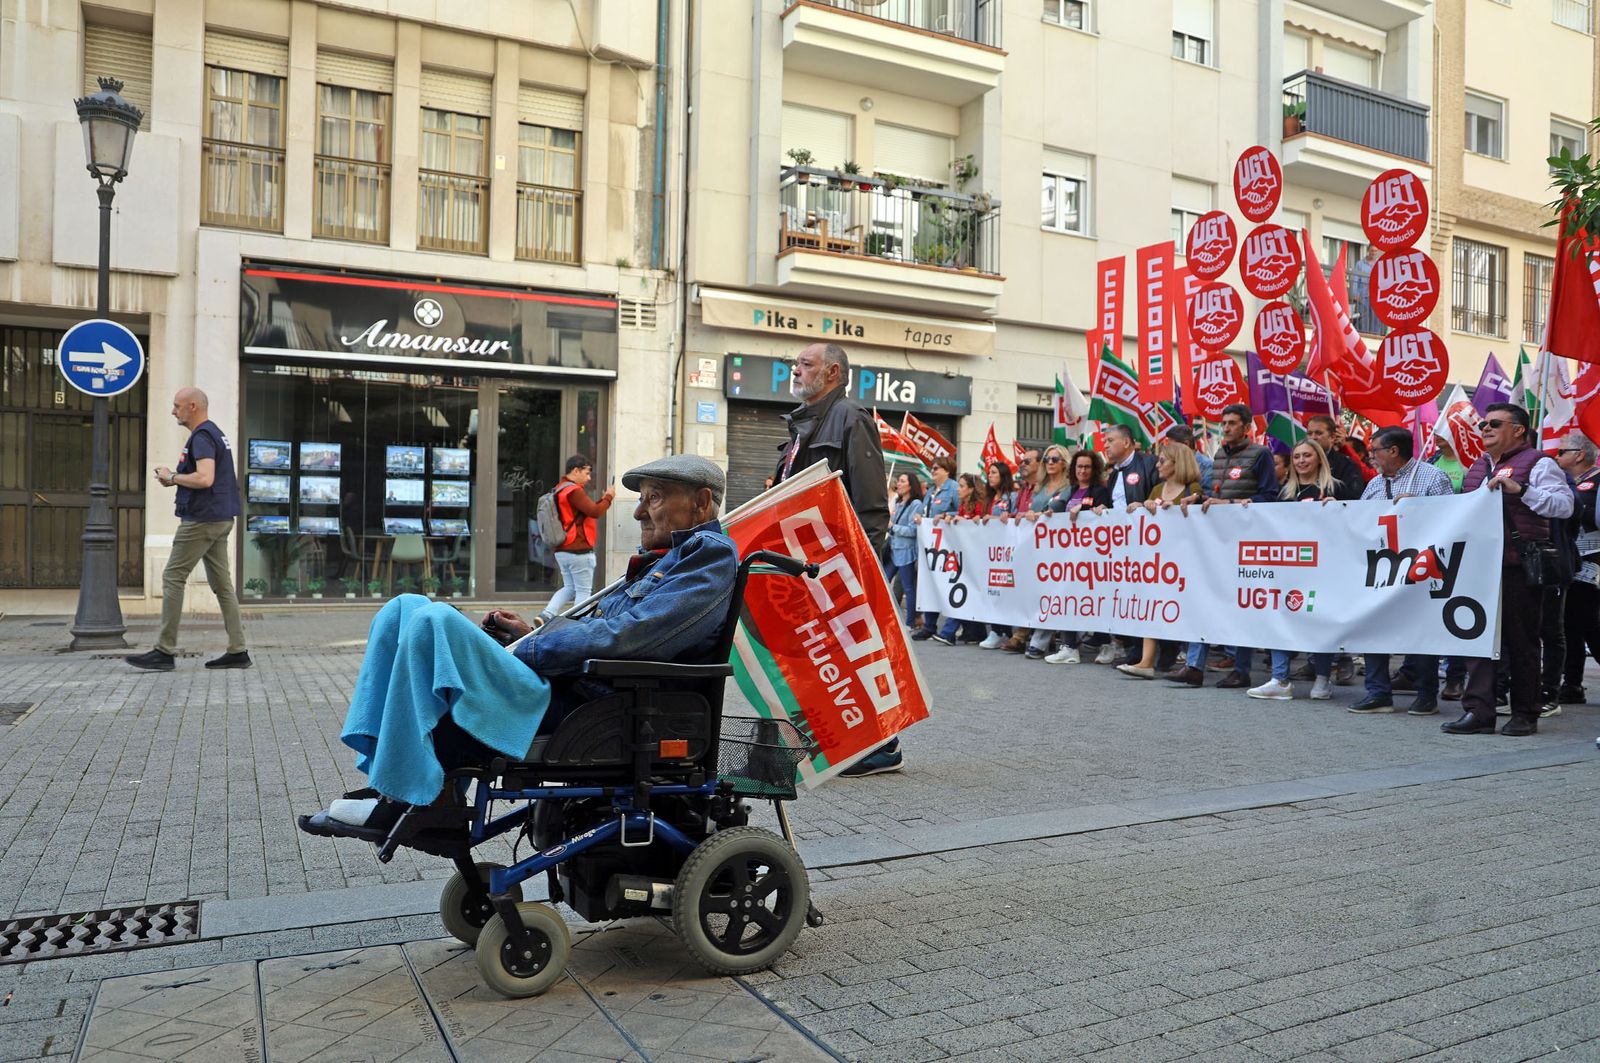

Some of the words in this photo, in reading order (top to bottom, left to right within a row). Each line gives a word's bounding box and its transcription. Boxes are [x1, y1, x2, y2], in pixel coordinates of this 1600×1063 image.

[1238, 150, 1272, 188] UGT
[1369, 173, 1415, 215] UGT
[1192, 214, 1230, 249] UGT
[1246, 228, 1290, 265] UGT
[1378, 228, 1416, 245] Andalucía
[1256, 278, 1289, 291] Andalucía
[1377, 252, 1427, 289] UGT
[1146, 256, 1164, 352] CCOO
[1194, 287, 1233, 320] UGT
[1386, 305, 1425, 321] Andalucía
[340, 319, 512, 356] Amansur
[753, 309, 798, 330] Pika
[822, 317, 865, 338] Pika
[904, 327, 953, 347] tapas
[1260, 306, 1297, 340] UGT
[1384, 331, 1434, 365] UGT
[858, 370, 916, 404] Pika
[1200, 359, 1234, 389] UGT
[1394, 384, 1434, 399] Andalucía
[1035, 521, 1132, 555] Proteger
[1139, 515, 1162, 546] lo
[1242, 546, 1294, 562] CCOO
[1036, 552, 1186, 592] conquistado,
[1238, 567, 1275, 580] Huelva
[779, 506, 901, 715] CCOO
[1039, 594, 1105, 623] ganar
[1112, 589, 1181, 624] futuro
[1237, 587, 1282, 611] UGT
[794, 618, 864, 729] Huelva
[571, 828, 597, 844] Mirage
